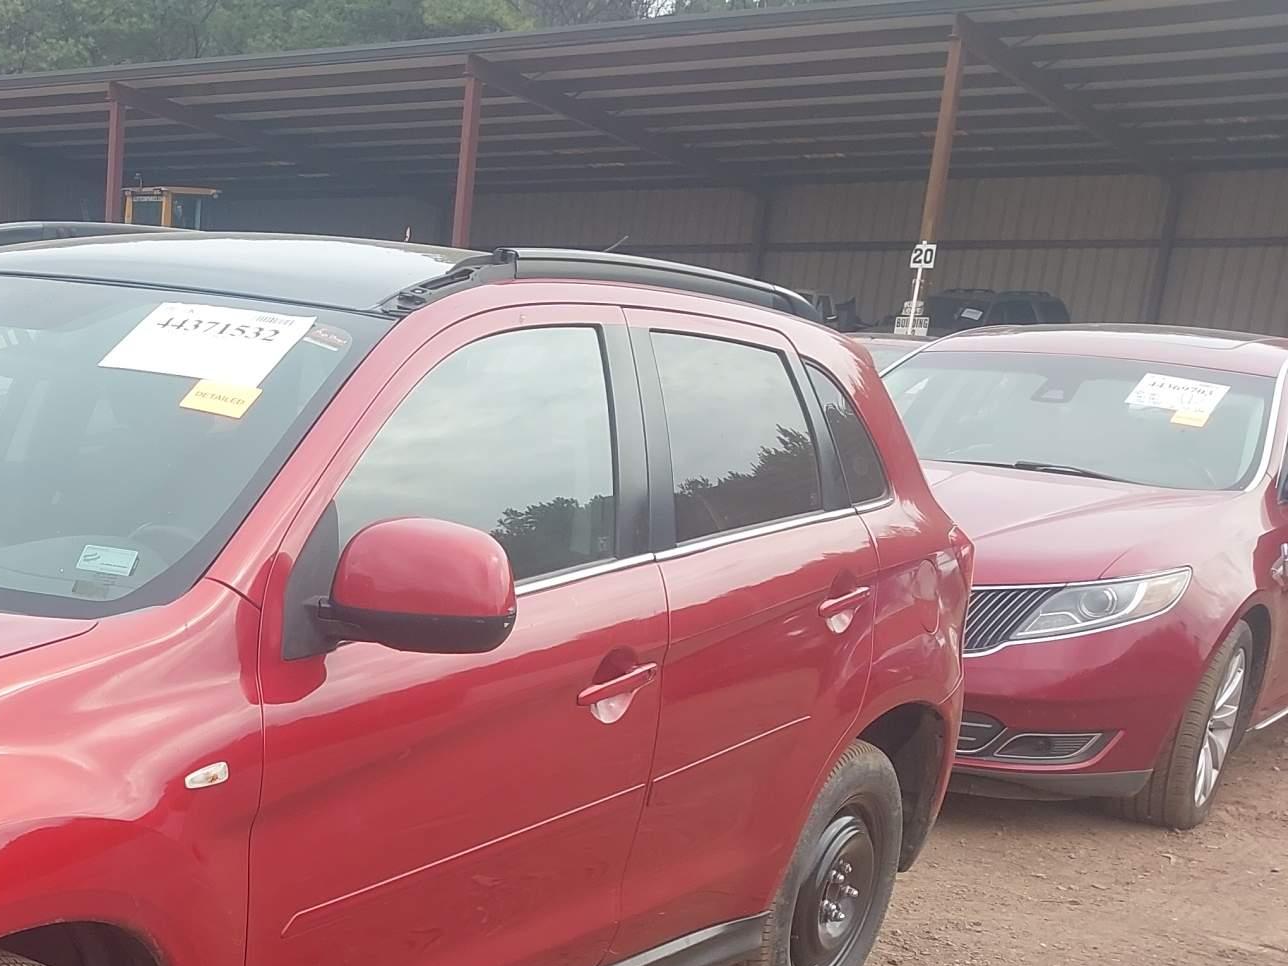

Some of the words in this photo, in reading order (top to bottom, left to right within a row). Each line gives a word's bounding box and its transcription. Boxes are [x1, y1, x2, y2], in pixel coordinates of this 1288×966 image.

[913, 248, 934, 265] 20
[156, 317, 280, 342] 44371532
[896, 318, 929, 329] BUIDING
[194, 390, 246, 405] DETAILED
